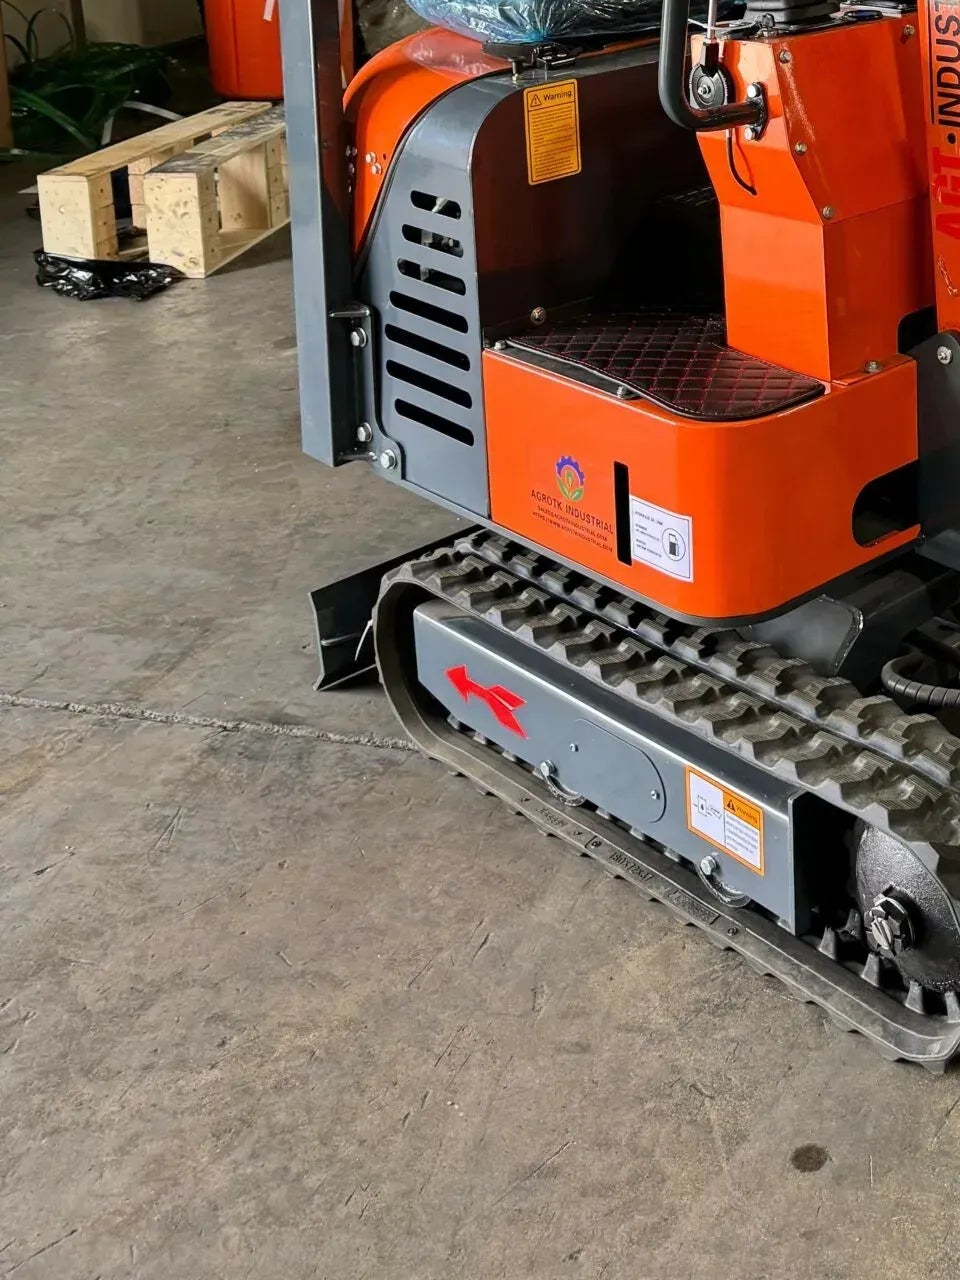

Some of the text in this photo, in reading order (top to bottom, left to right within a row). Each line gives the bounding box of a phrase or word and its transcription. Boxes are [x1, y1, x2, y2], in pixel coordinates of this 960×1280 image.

[543, 90, 572, 101] Warning
[531, 489, 563, 511] AGROTK
[566, 504, 614, 535] INDUSTRIAL
